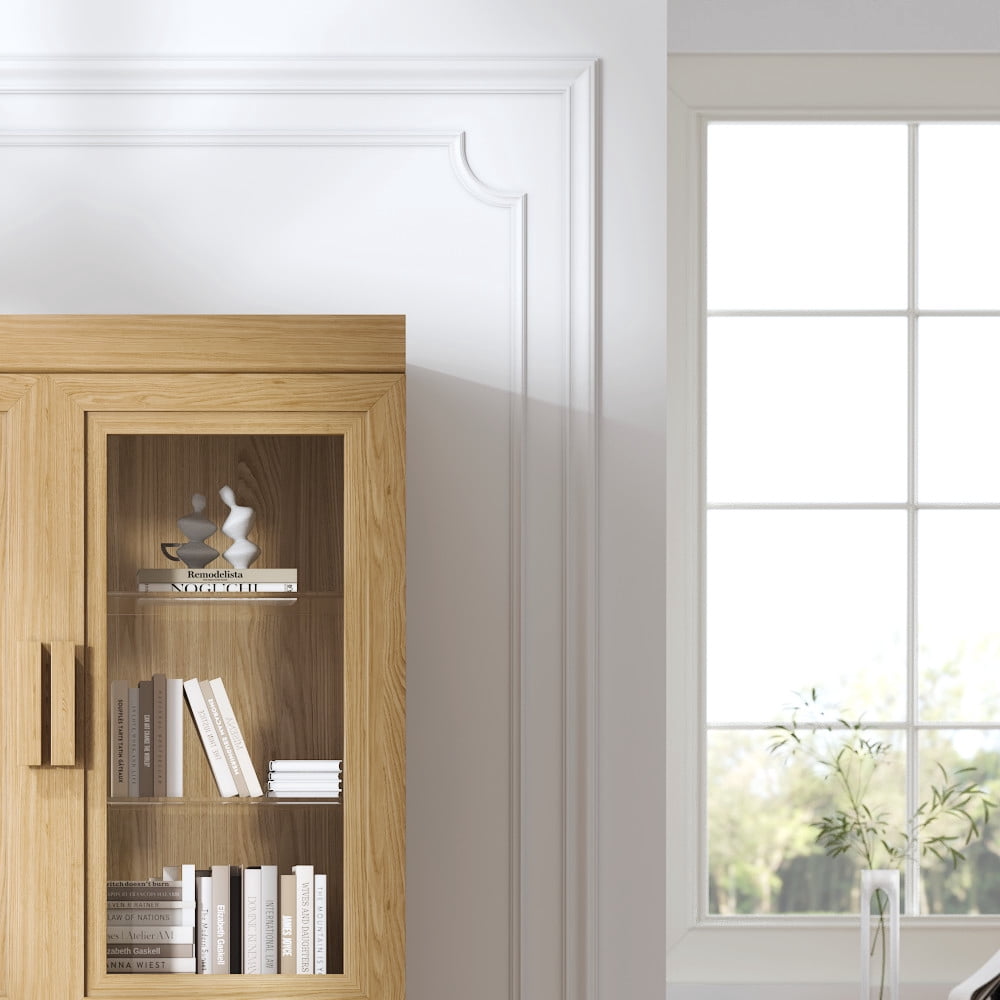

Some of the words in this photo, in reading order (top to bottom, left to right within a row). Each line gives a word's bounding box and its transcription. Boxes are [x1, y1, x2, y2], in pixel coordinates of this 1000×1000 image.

[187, 570, 243, 578] Remodelista
[171, 583, 258, 592] NOGUCHI
[302, 882, 310, 907] WIVES
[217, 904, 225, 937] Elizabeth
[265, 900, 274, 952] INTERNATIONAL
[302, 908, 310, 924] AND
[133, 947, 161, 955] Gaskell
[217, 938, 225, 965] Gaskell
[302, 926, 310, 973] DAUGHTERS
[265, 955, 274, 968] LAW
